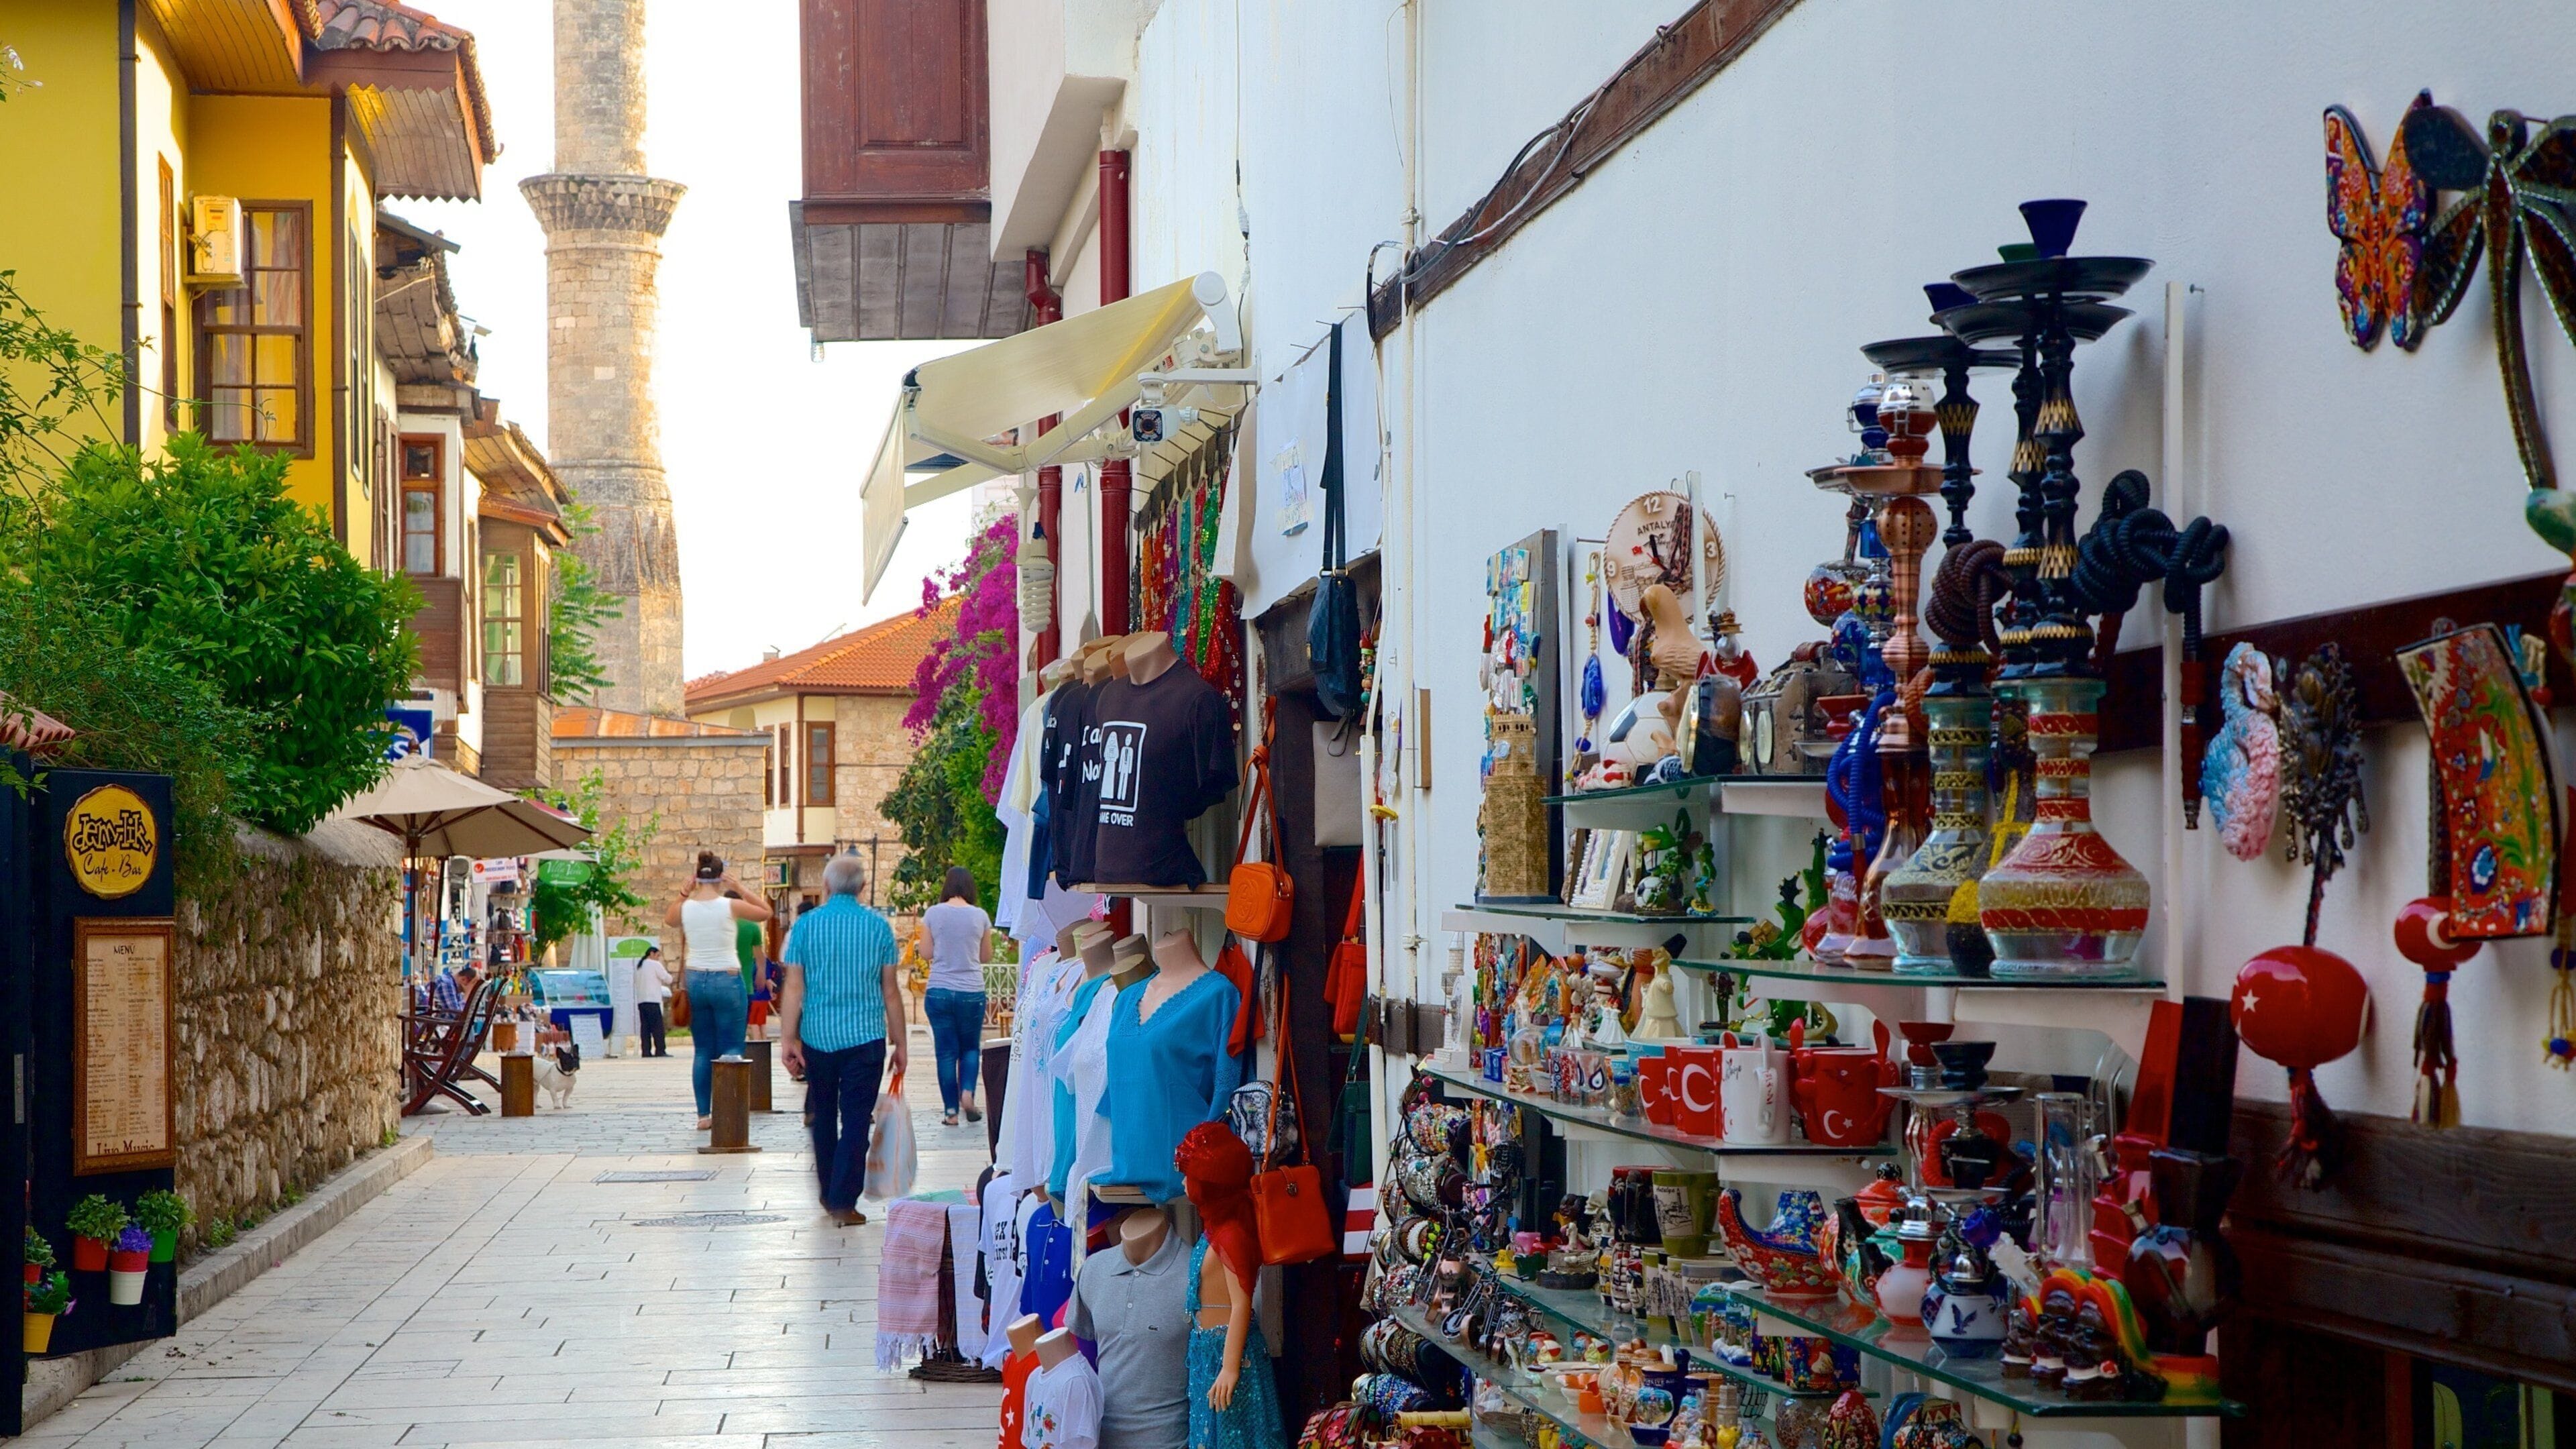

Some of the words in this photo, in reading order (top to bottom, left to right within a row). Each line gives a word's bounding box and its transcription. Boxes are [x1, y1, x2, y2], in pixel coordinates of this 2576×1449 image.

[1644, 496, 1662, 514] 12
[1705, 541, 1717, 557] 3
[1607, 561, 1617, 577] 9
[1090, 728, 1101, 744] a
[1111, 812, 1134, 826] OVER
[83, 853, 109, 882] Cafe
[119, 853, 142, 877] Bar
